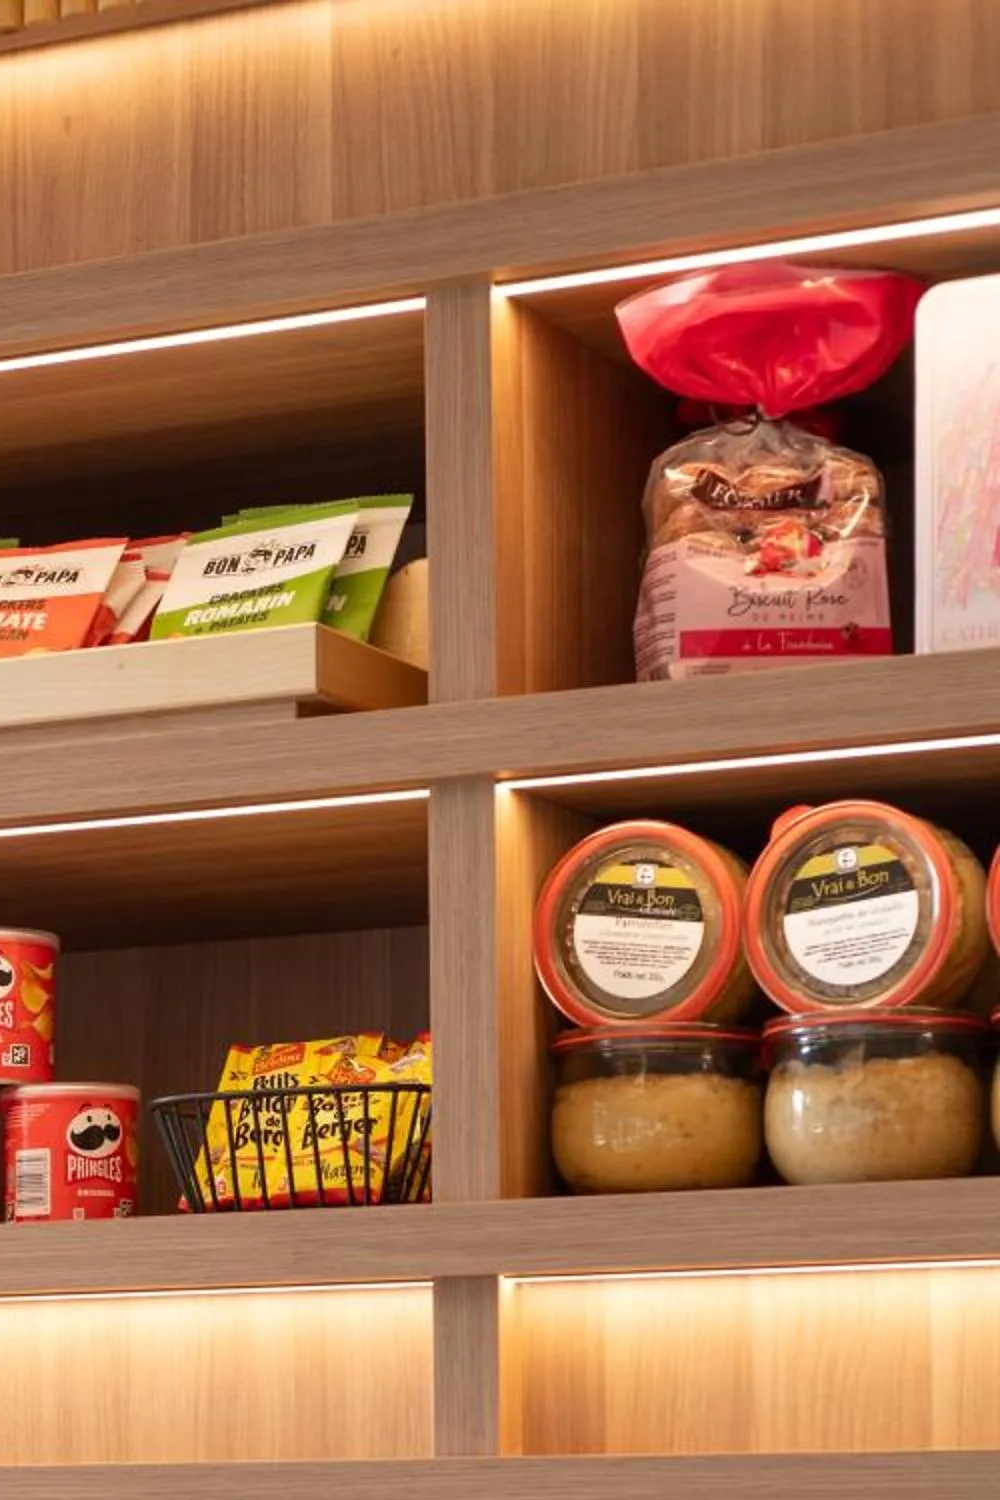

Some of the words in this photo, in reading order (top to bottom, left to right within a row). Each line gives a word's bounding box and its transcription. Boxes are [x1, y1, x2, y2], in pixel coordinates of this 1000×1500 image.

[346, 534, 367, 555] PA
[203, 556, 241, 576] BON
[273, 543, 316, 566] PAPA
[34, 569, 80, 583] PAPA
[184, 591, 296, 626] ROMARIN
[607, 887, 635, 906] Vrai
[647, 887, 676, 907] Bon
[811, 878, 844, 898] Vrai
[856, 869, 889, 888] Bon
[67, 1153, 122, 1183] PRINGLES
